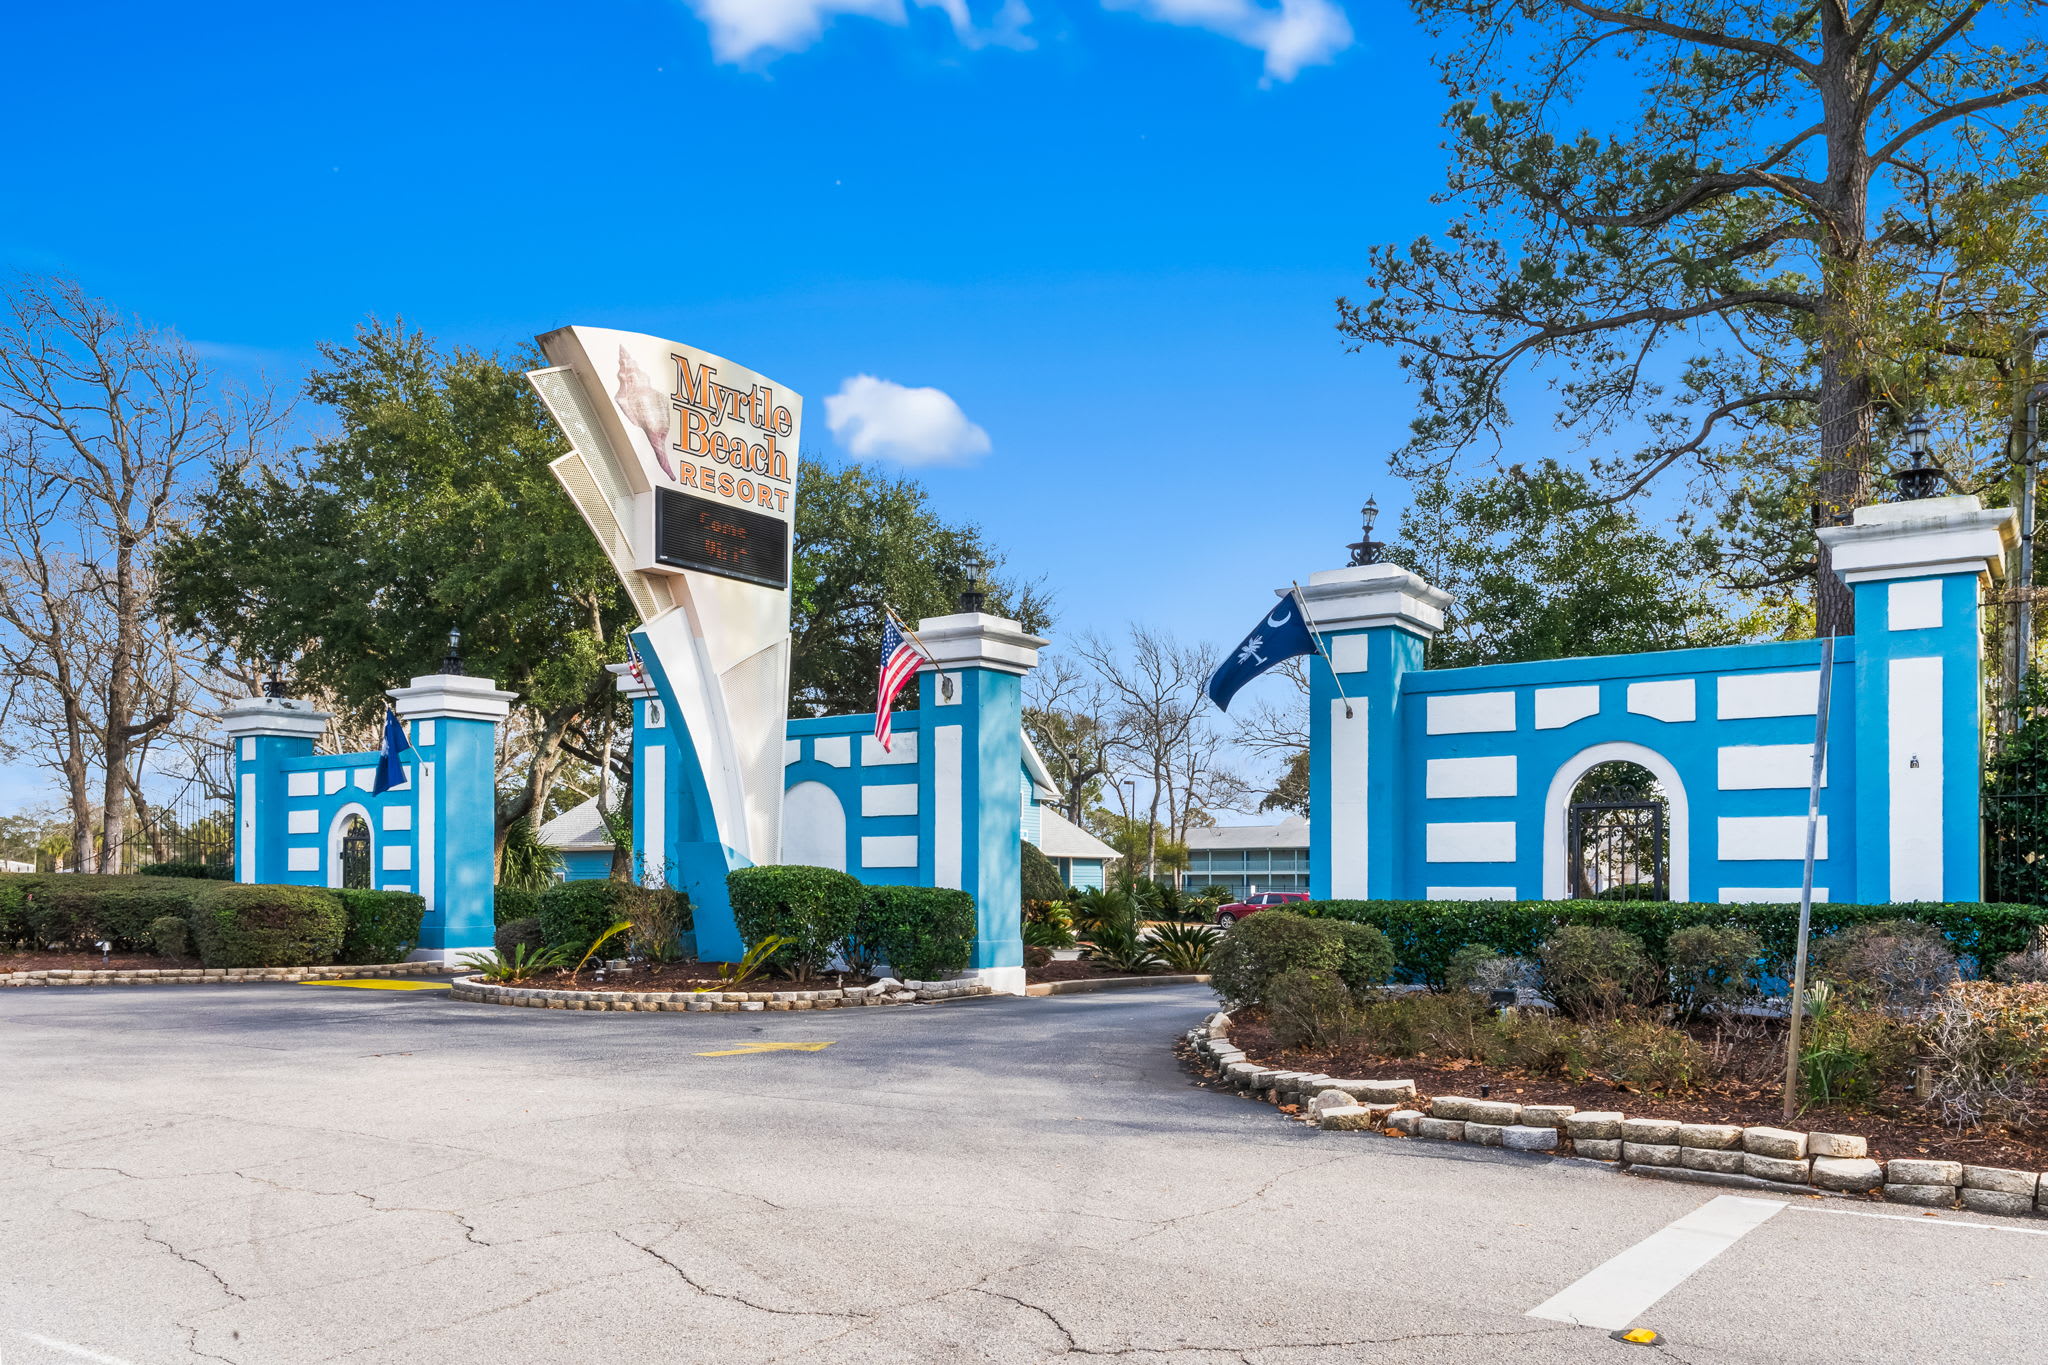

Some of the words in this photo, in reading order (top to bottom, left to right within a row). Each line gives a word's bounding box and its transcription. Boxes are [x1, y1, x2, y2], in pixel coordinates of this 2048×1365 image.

[671, 353, 792, 437] Myrtle
[673, 404, 791, 484] Beach
[680, 461, 788, 512] RESORT
